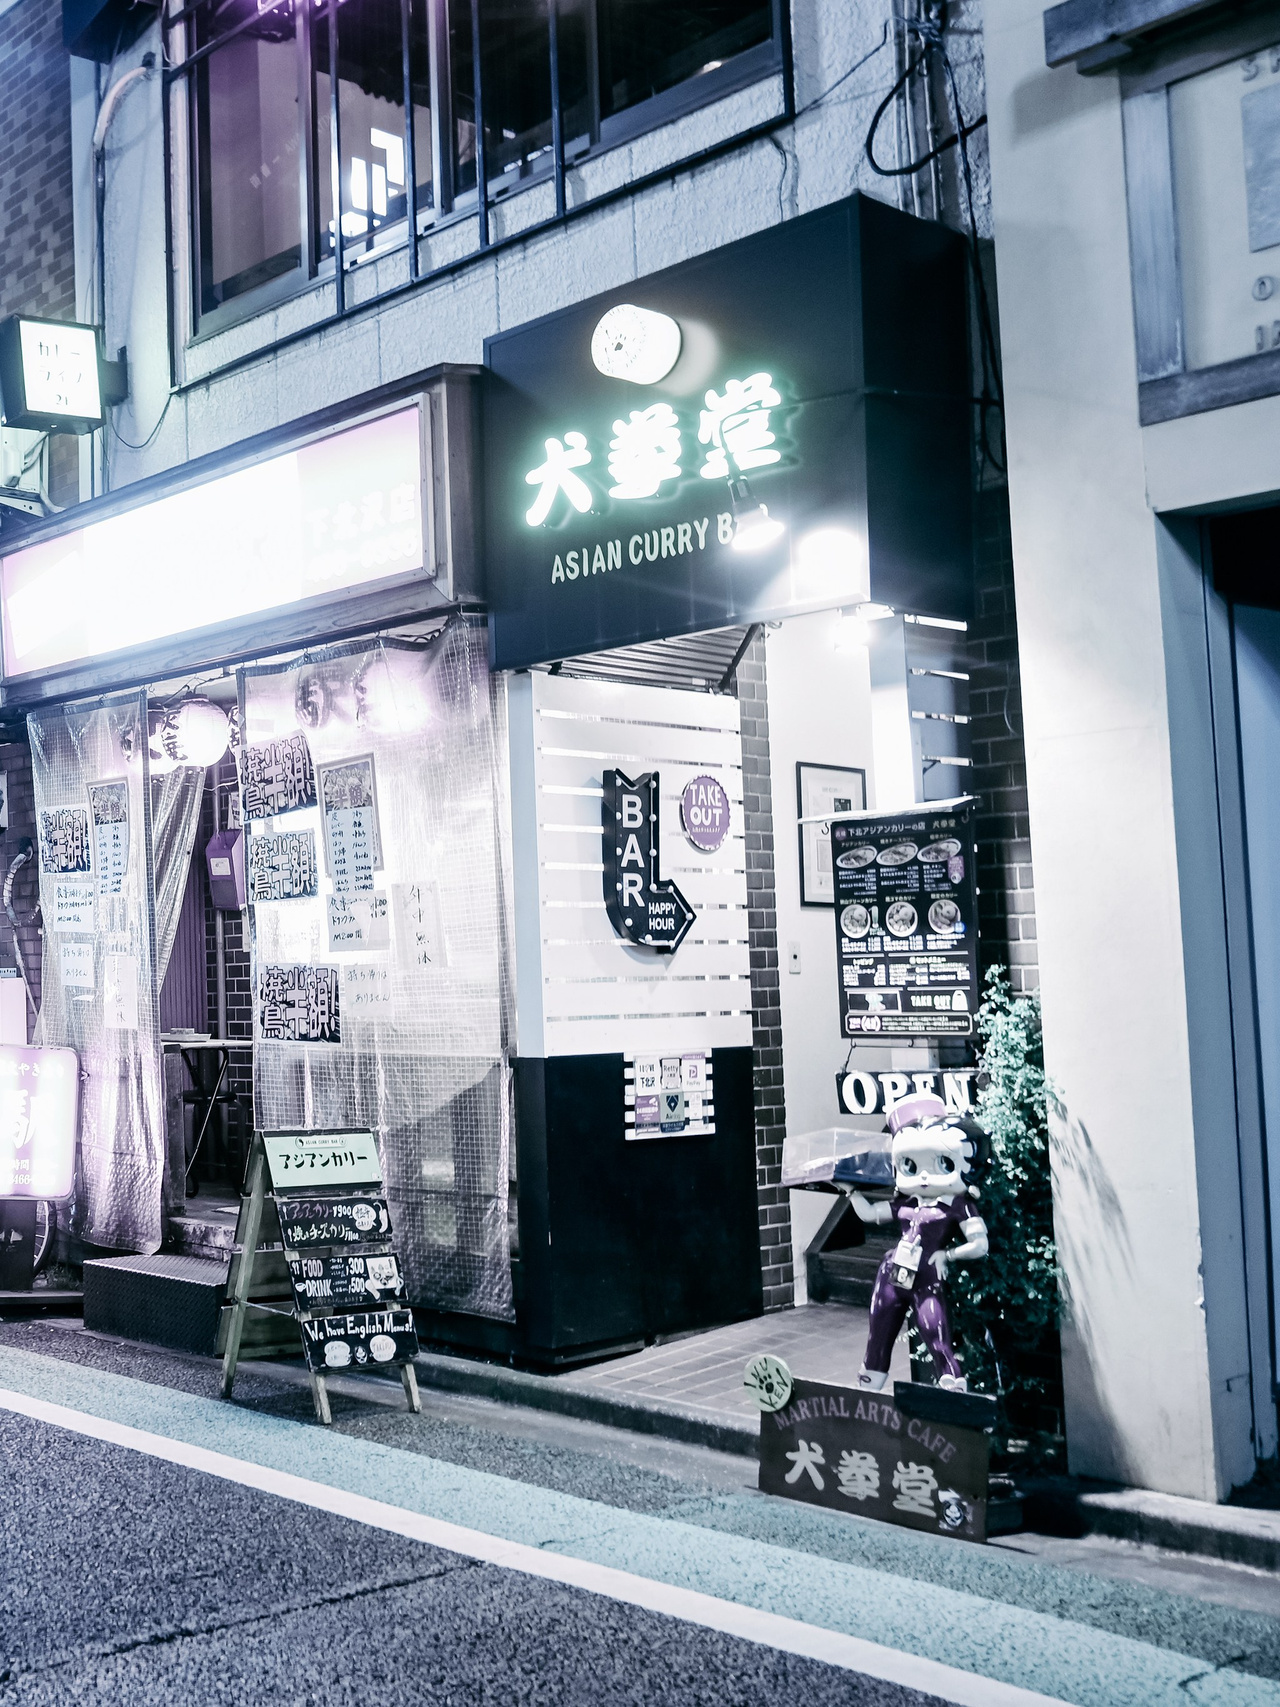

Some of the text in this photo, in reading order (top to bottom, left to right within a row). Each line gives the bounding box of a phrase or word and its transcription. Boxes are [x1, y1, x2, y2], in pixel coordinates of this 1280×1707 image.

[551, 538, 622, 584] ASIAN
[628, 516, 710, 566] CURRY
[690, 784, 722, 807] TAKE
[690, 806, 723, 826] OUT
[621, 794, 645, 907] BAR
[648, 902, 676, 916] HAPPY
[648, 917, 675, 931] HOUR
[841, 1071, 972, 1114] OPEN
[278, 1151, 368, 1170] アジアンカリー
[301, 1259, 323, 1278] FOOD
[305, 1279, 333, 1297] DRINK
[304, 1320, 324, 1341] We
[324, 1319, 345, 1337] have
[346, 1313, 382, 1339] English
[773, 1396, 956, 1464] MARTIAL ARTS CAFE
